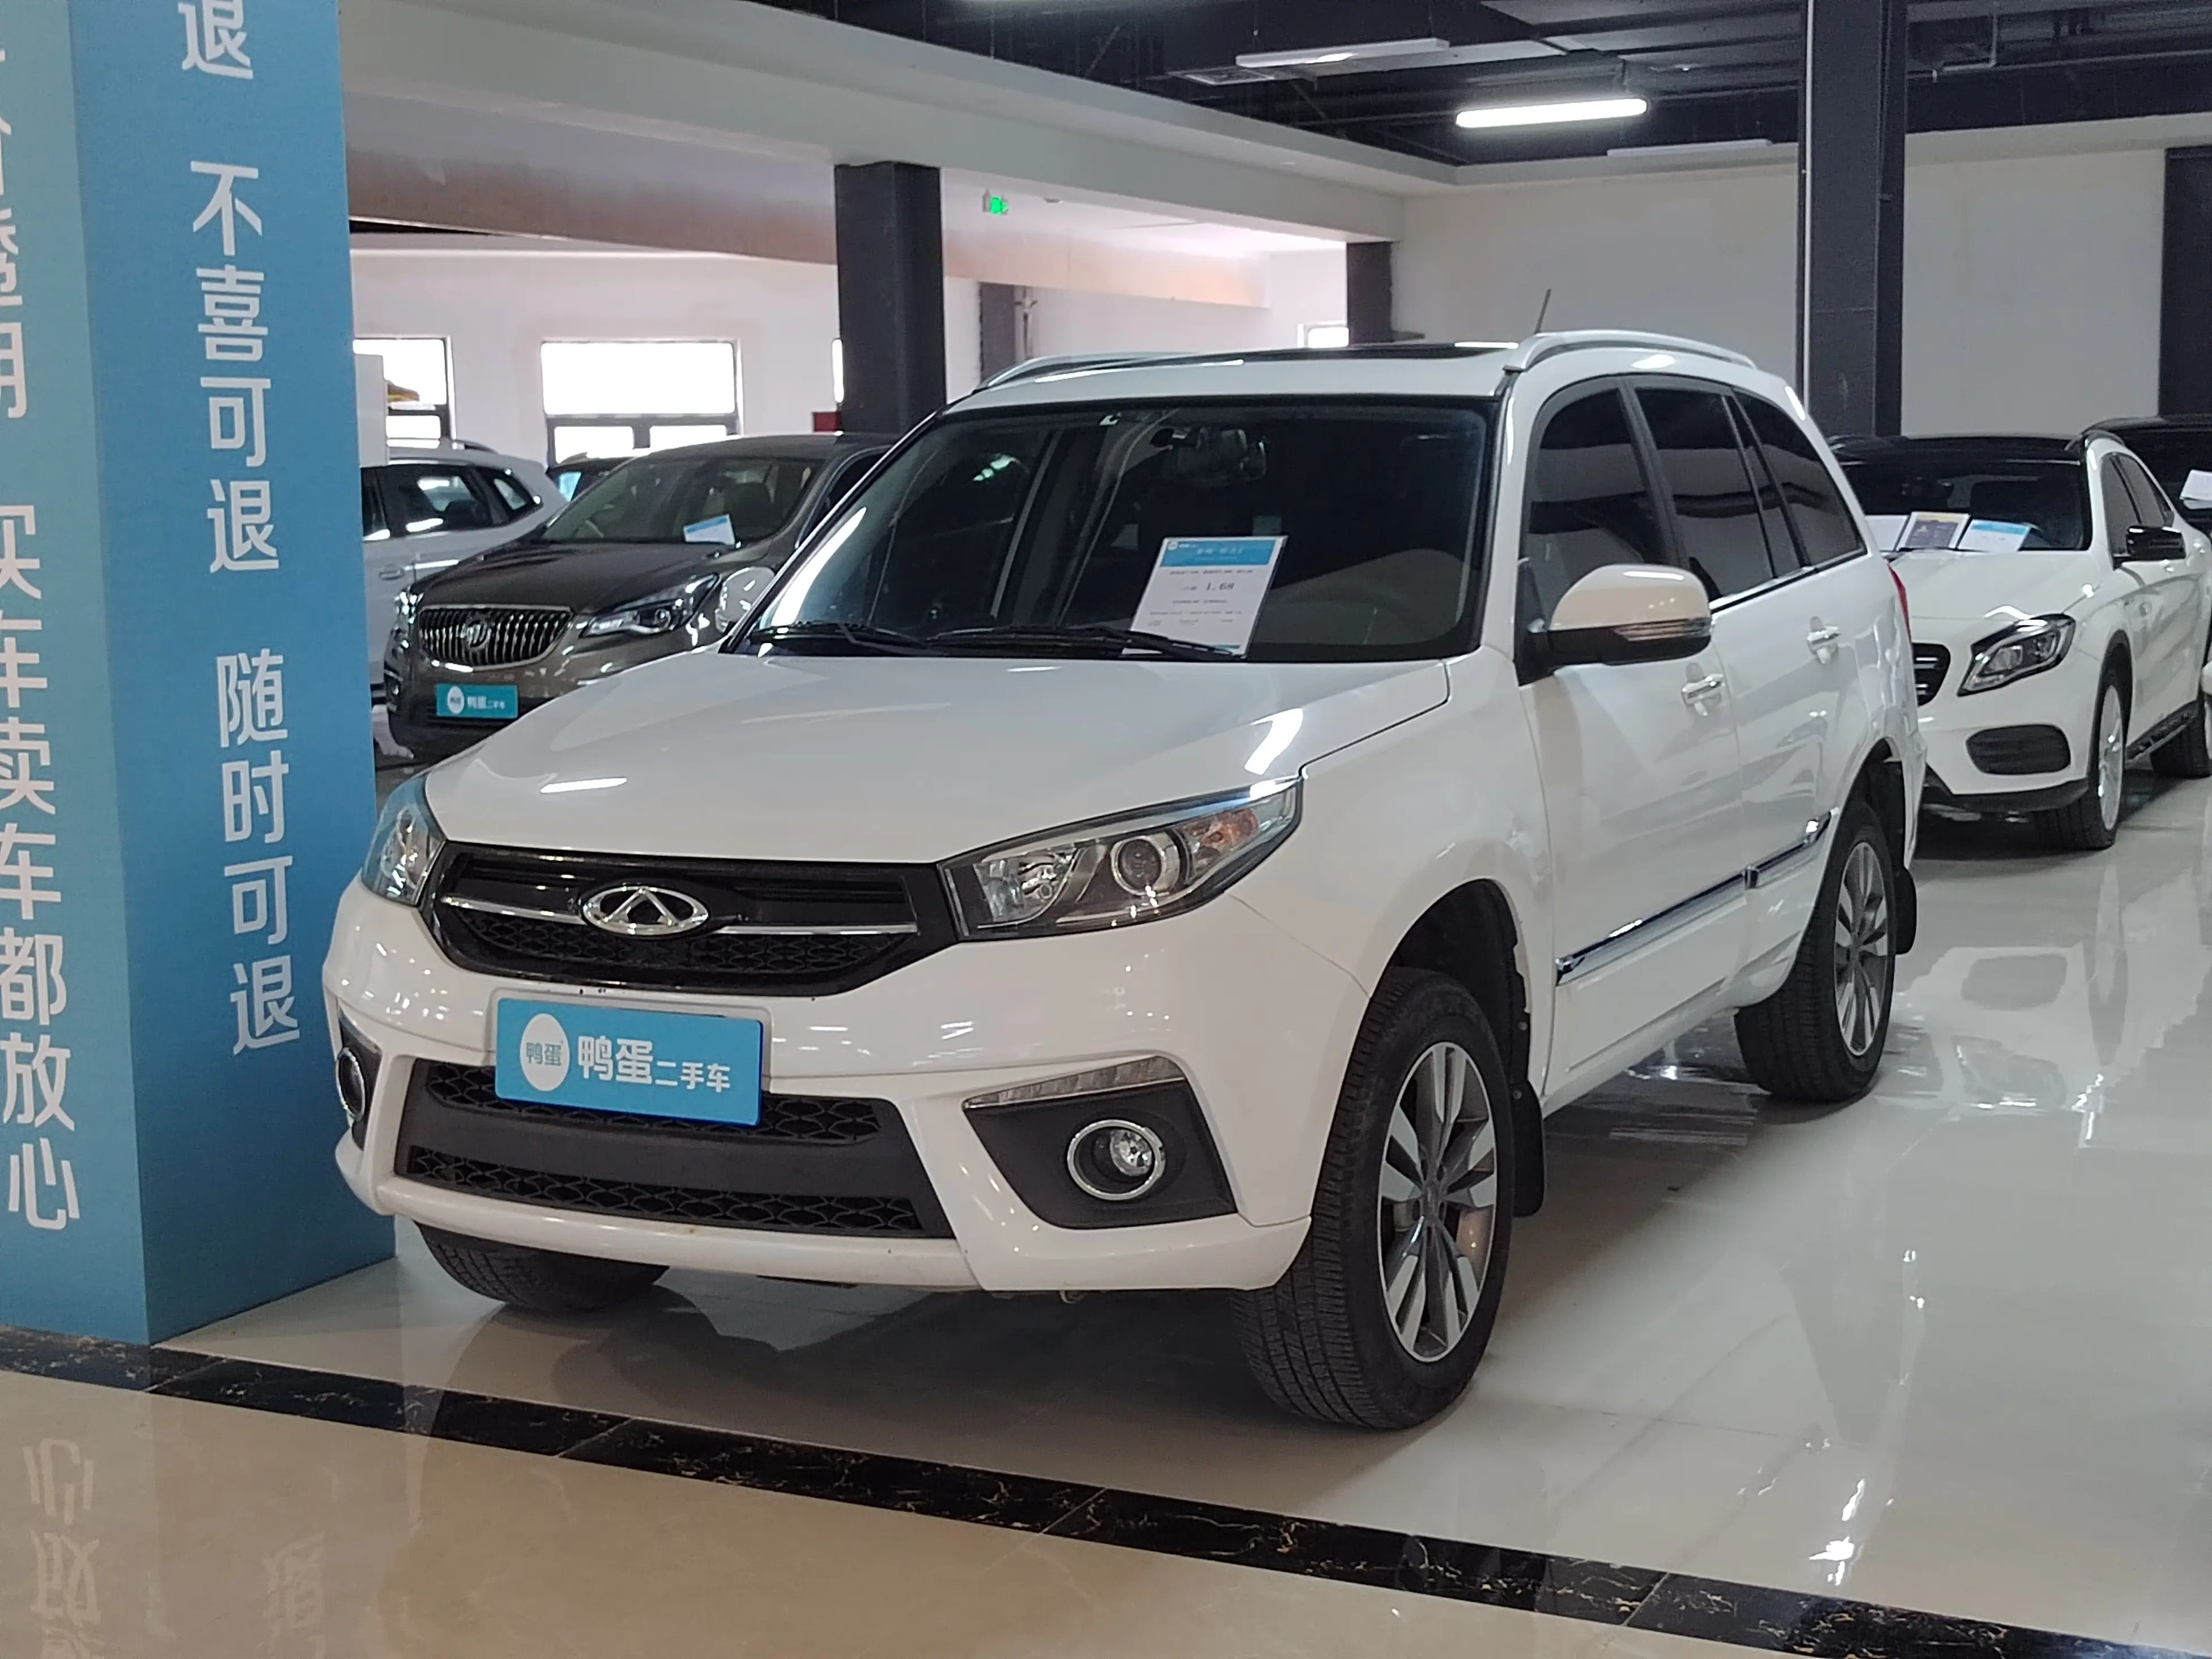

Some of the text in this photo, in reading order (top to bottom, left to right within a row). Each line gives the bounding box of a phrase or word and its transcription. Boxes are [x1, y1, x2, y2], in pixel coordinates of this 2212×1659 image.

[177, 0, 300, 1056] 退 不喜可退 随时可退
[526, 1042, 563, 1066] 鸭蛋
[578, 1035, 731, 1092] 鸭蛋二手车
